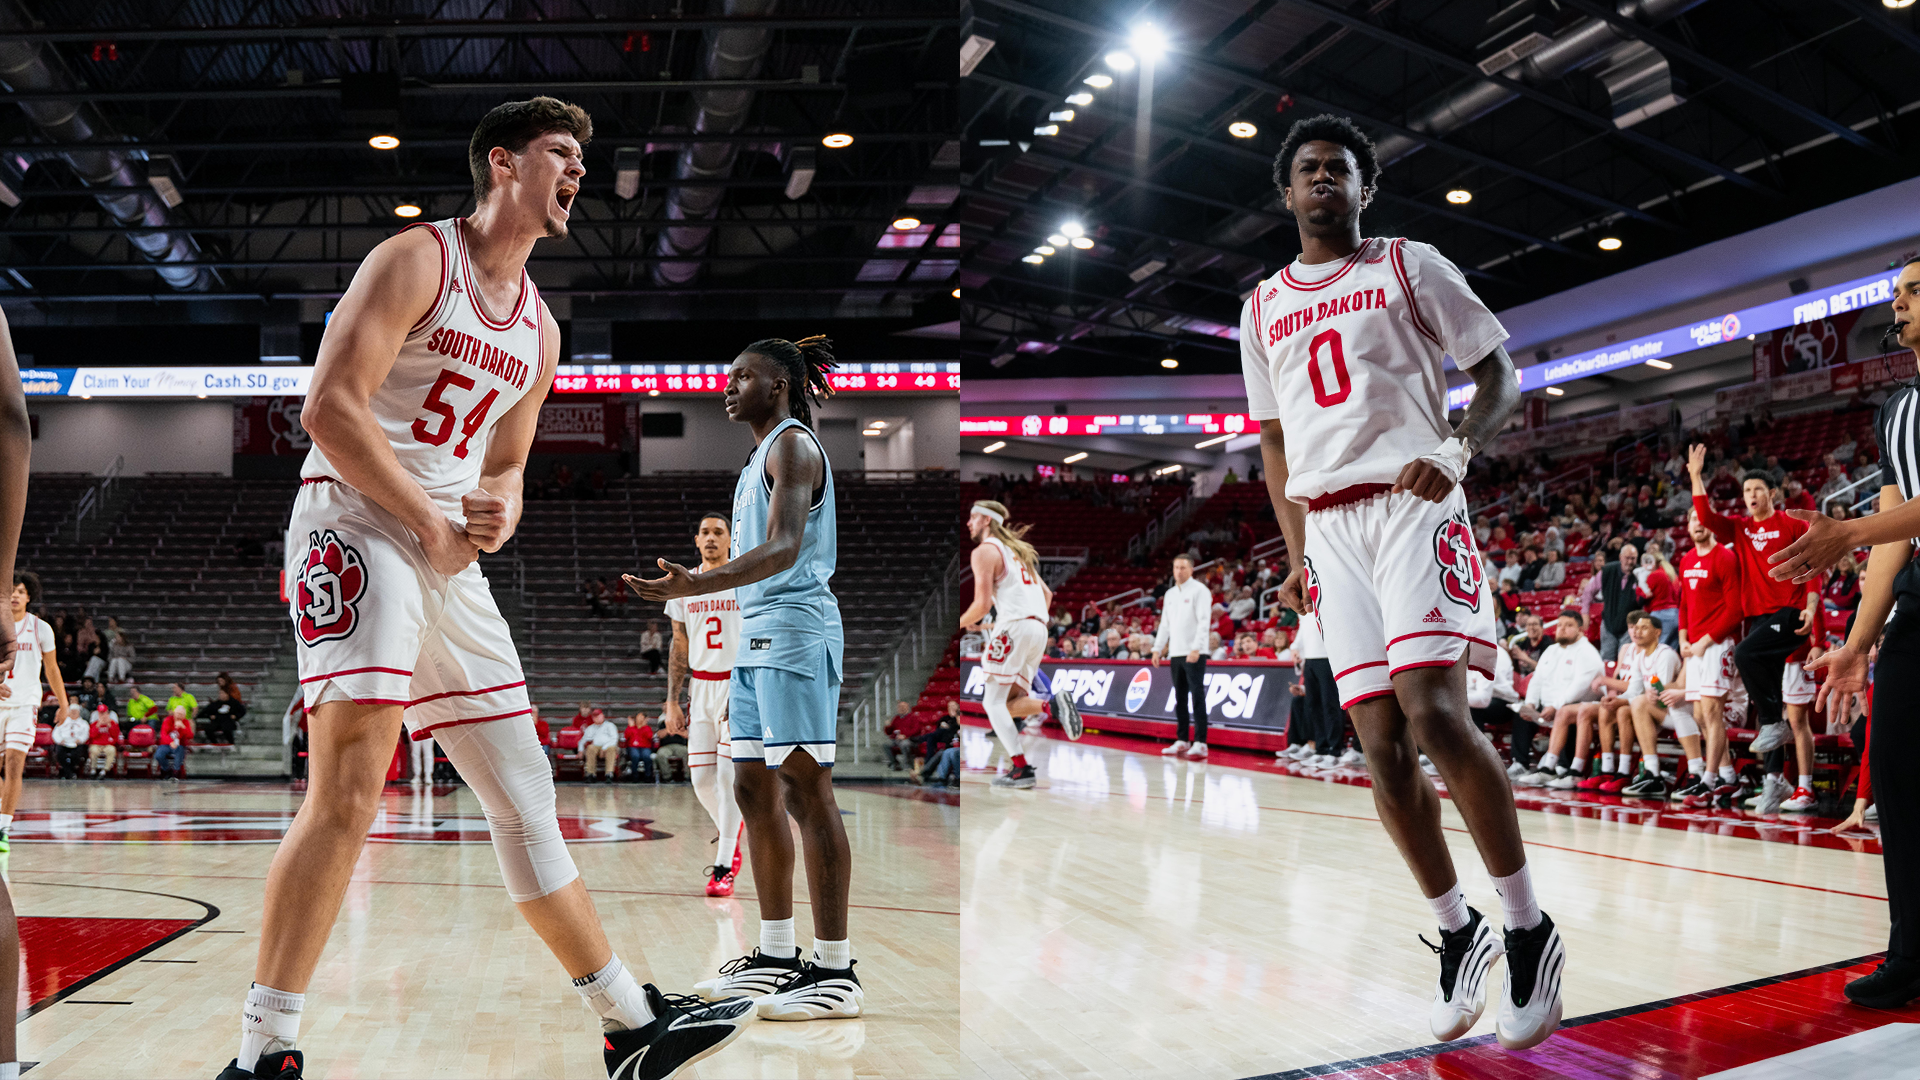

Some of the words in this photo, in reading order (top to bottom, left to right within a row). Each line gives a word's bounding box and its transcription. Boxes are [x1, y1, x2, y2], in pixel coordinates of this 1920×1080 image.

[1268, 306, 1314, 347] SOUTH
[1315, 288, 1387, 322] DAKOTA
[1793, 299, 1828, 325] FIND
[1830, 279, 1890, 315] BETTER
[427, 326, 482, 366] SOUTH
[479, 342, 529, 391] DAKOTA
[1308, 328, 1351, 408] 0
[83, 374, 119, 388] Claim
[123, 374, 150, 388] Your
[204, 374, 299, 391] Cash.SD.gov
[686, 376, 703, 390] 10
[706, 376, 717, 390] 3
[411, 368, 500, 460] 54
[688, 600, 708, 613] SOUTH
[706, 617, 723, 649] 2
[1051, 669, 1115, 706] PEPSI
